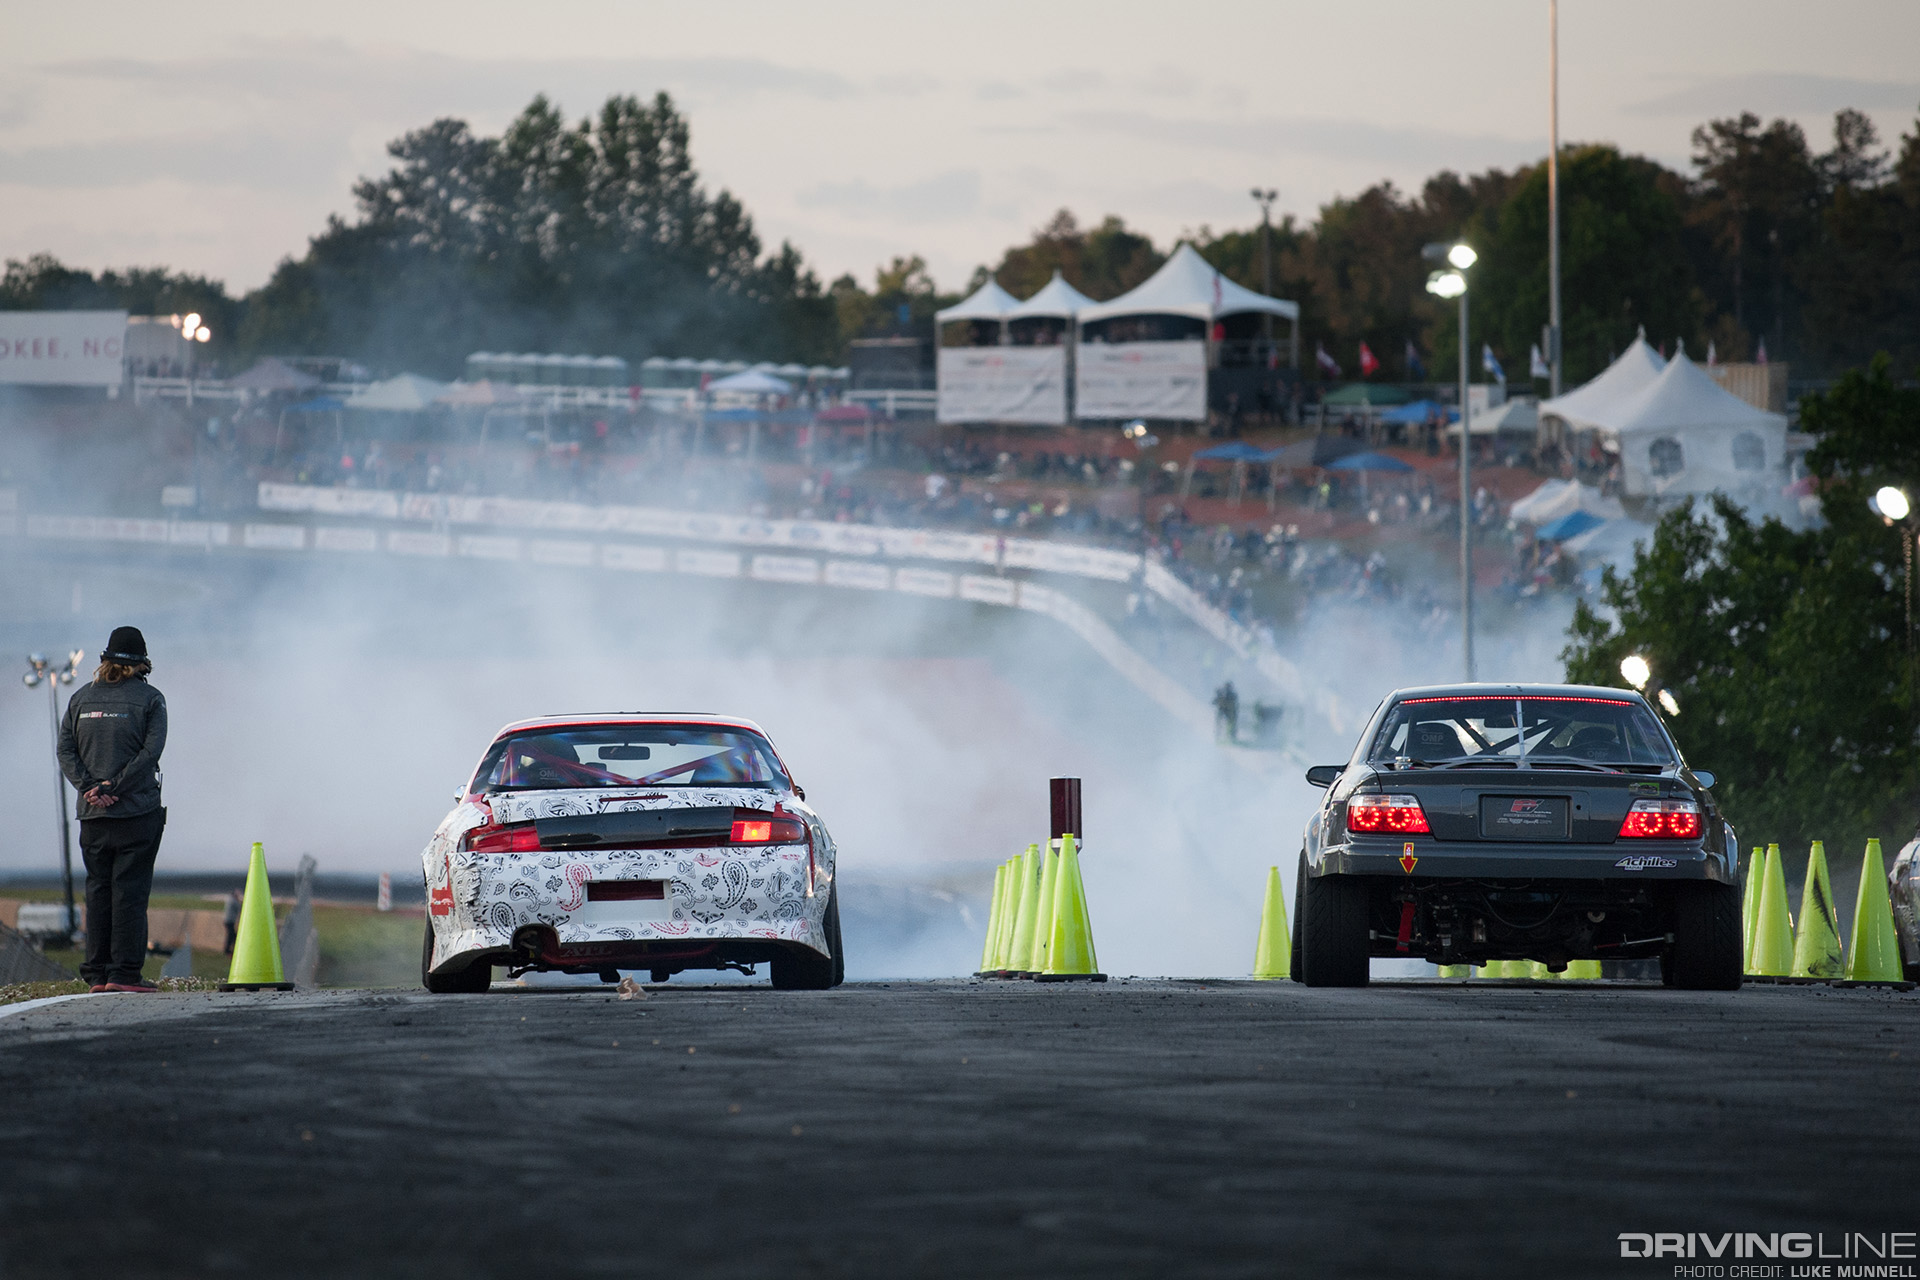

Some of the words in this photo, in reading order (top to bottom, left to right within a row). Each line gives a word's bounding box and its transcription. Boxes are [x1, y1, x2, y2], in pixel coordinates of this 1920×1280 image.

[83, 337, 121, 359] NC
[1421, 734, 1444, 743] OMP
[1615, 856, 1678, 868] Achilles
